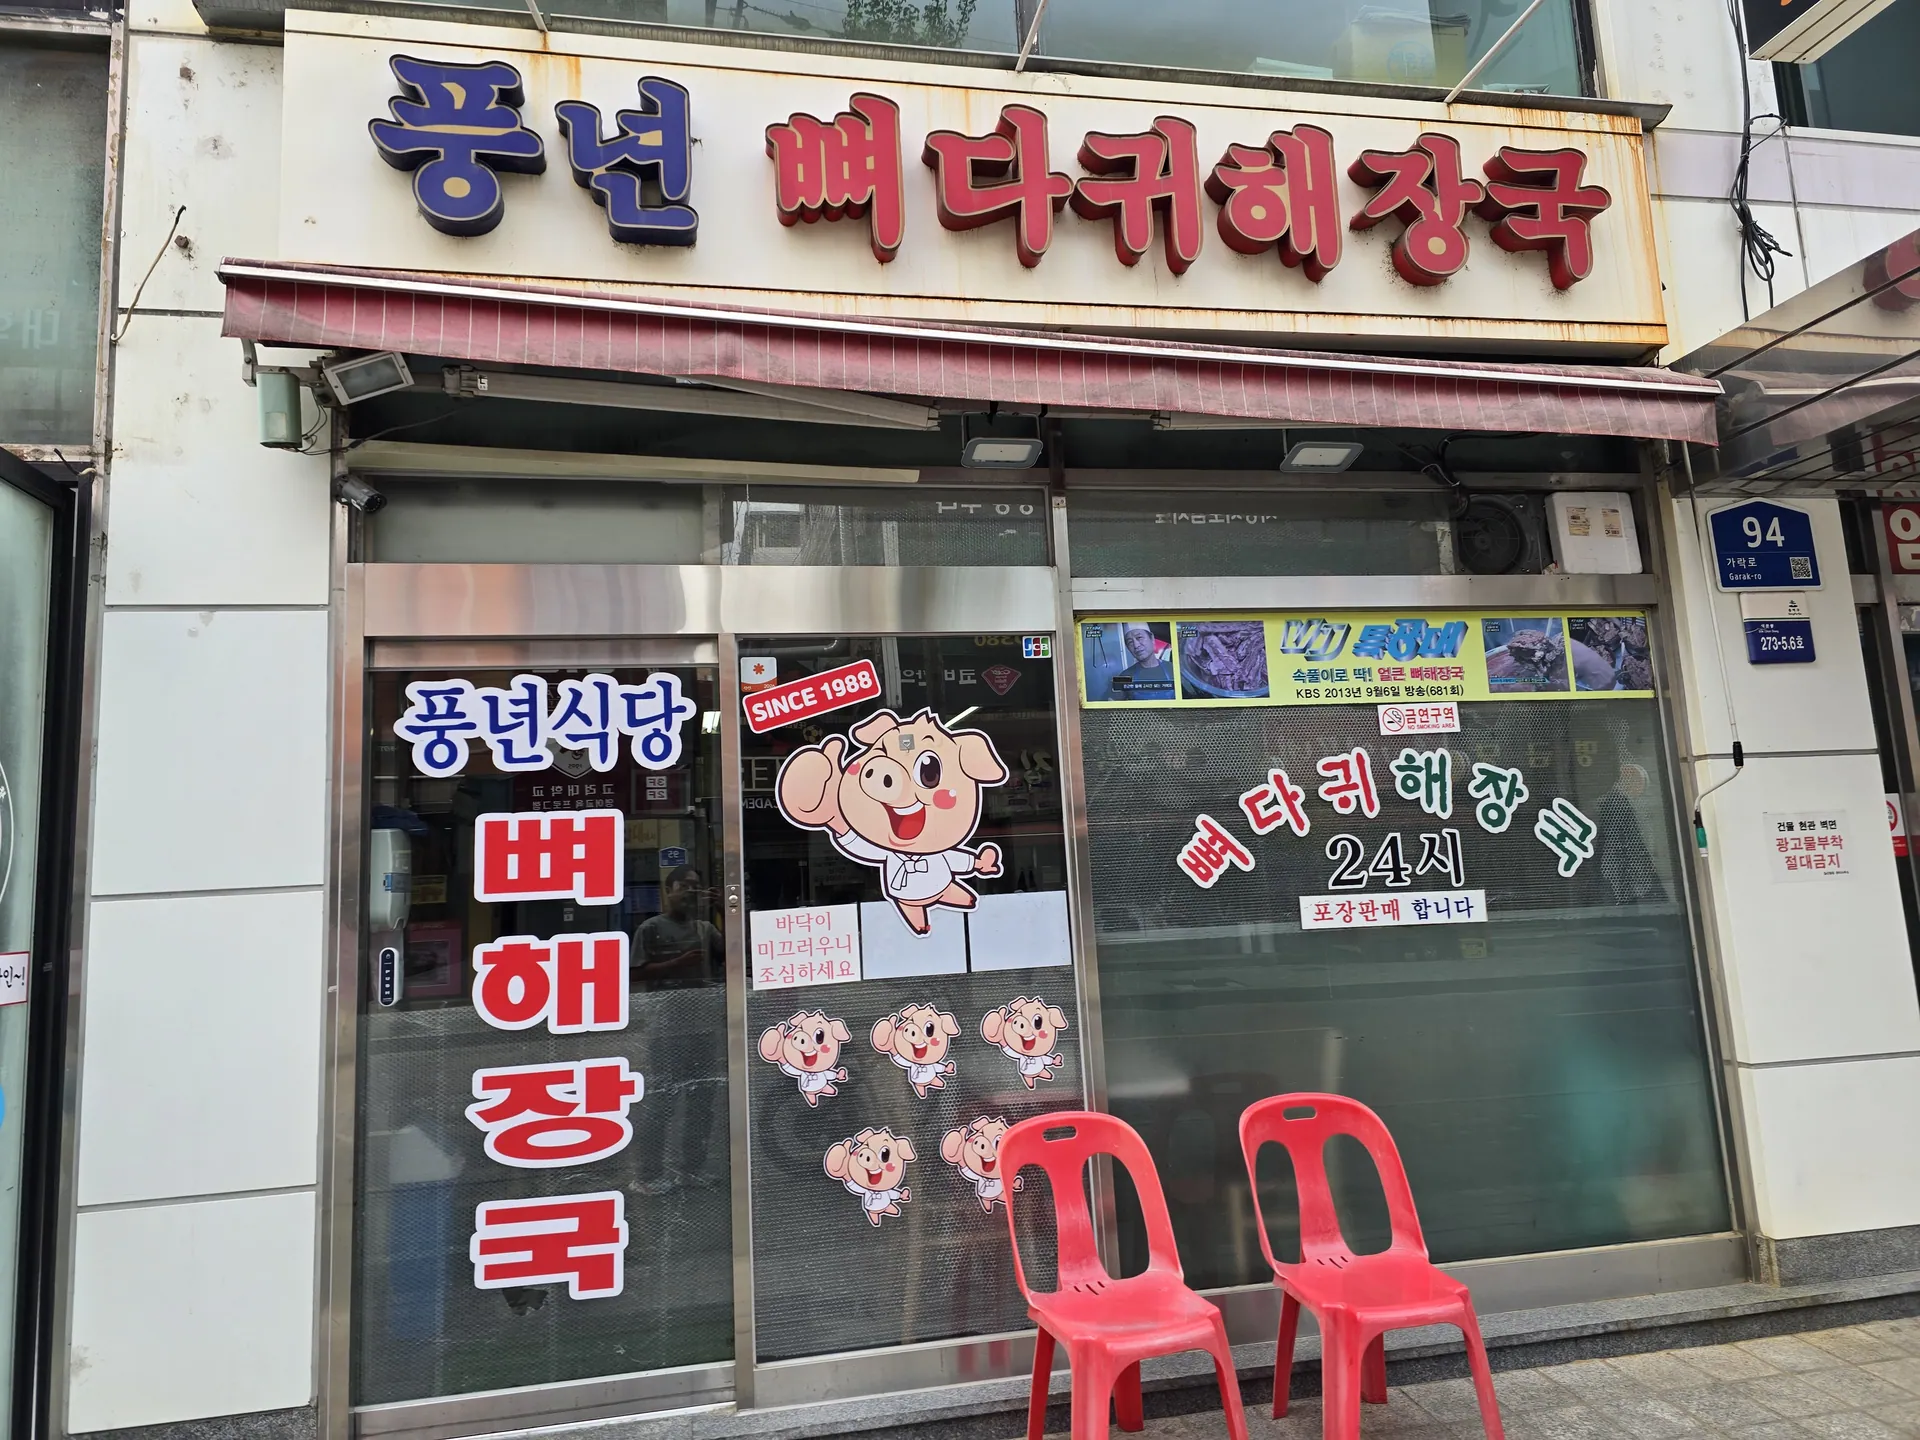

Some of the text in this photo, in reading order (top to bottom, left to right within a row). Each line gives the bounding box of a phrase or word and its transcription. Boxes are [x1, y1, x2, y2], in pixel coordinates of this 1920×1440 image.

[367, 53, 1611, 292] 풍년 뼈다귀해장국
[1742, 516, 1785, 548] 94
[1726, 557, 1758, 569] 가락로
[1728, 572, 1762, 581] Garak-ro
[1292, 666, 1465, 683] 속풀이로 딱! 얼큰 뼈해장국
[752, 687, 818, 722] SINCE
[820, 670, 873, 701] 1988
[1296, 685, 1464, 699] KBS 2013년 9월6일 방송(681회)
[403, 679, 690, 771] 풍년식당
[1405, 707, 1455, 724] 금연구역
[1777, 821, 1794, 832] 건물
[1776, 835, 1843, 852] 광고물부착
[1327, 830, 1464, 888] 24시
[1785, 853, 1841, 870] 절대금지
[1313, 897, 1474, 923] 포장판매 합니다
[776, 911, 831, 933] 바닥이
[758, 934, 851, 960] 미끄러우니
[758, 960, 855, 984] 조심하세요
[474, 814, 638, 1294] 뼈해장국
